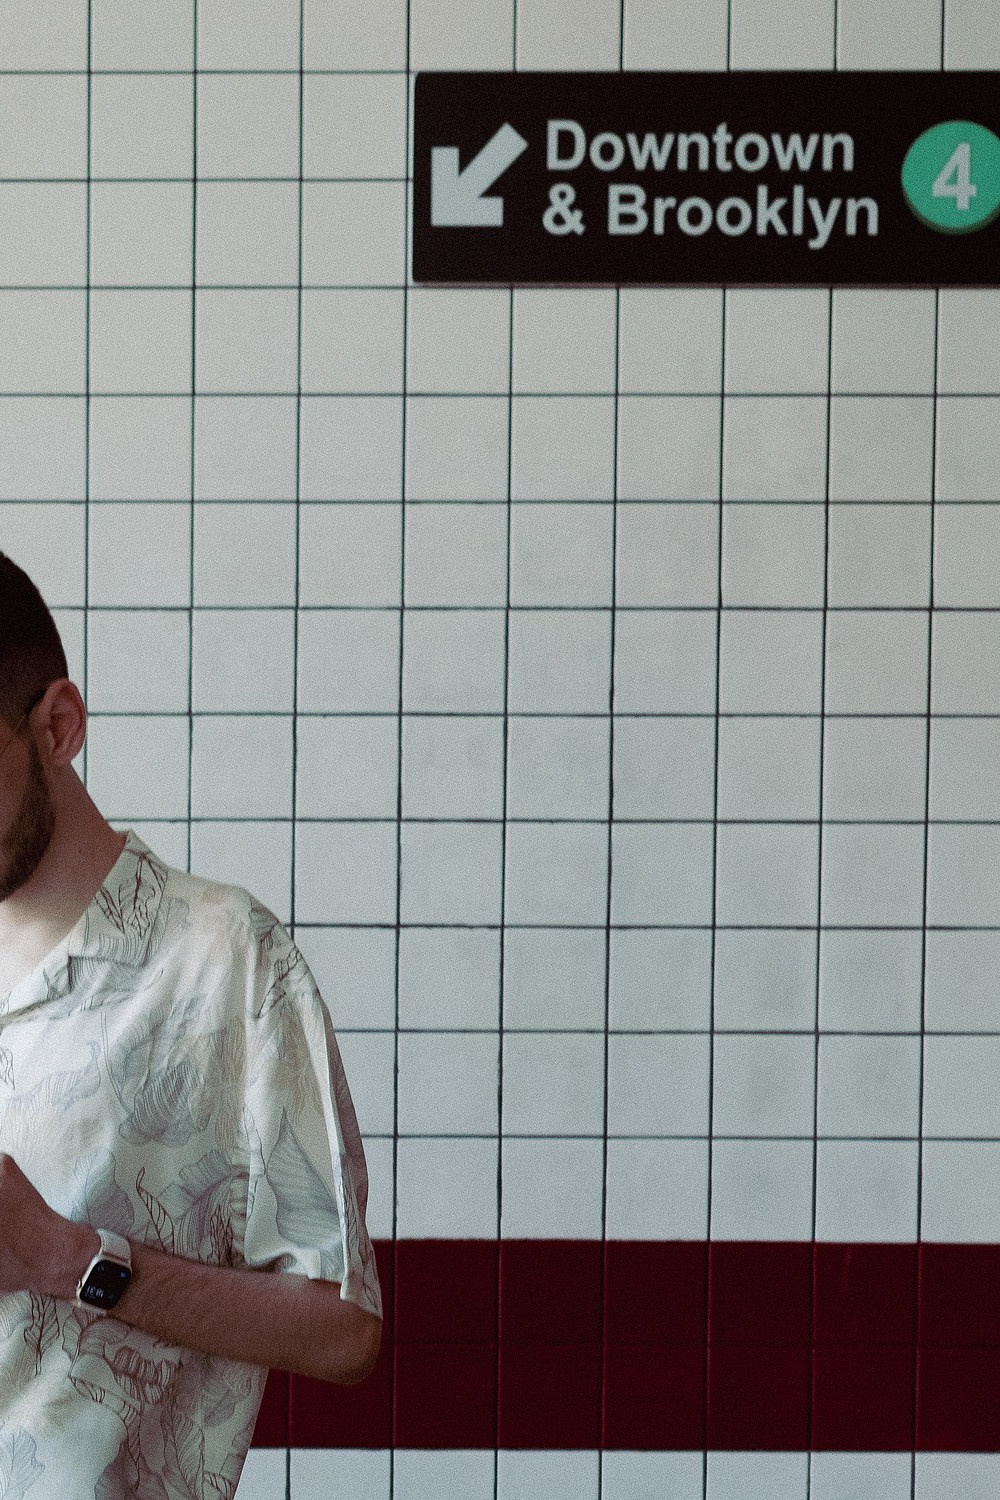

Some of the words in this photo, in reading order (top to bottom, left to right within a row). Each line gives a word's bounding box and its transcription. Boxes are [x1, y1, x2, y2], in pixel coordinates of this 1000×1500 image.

[547, 119, 854, 170] Downtown
[932, 142, 977, 210] 4
[542, 183, 586, 235] &
[608, 184, 879, 249] Brooklyn
